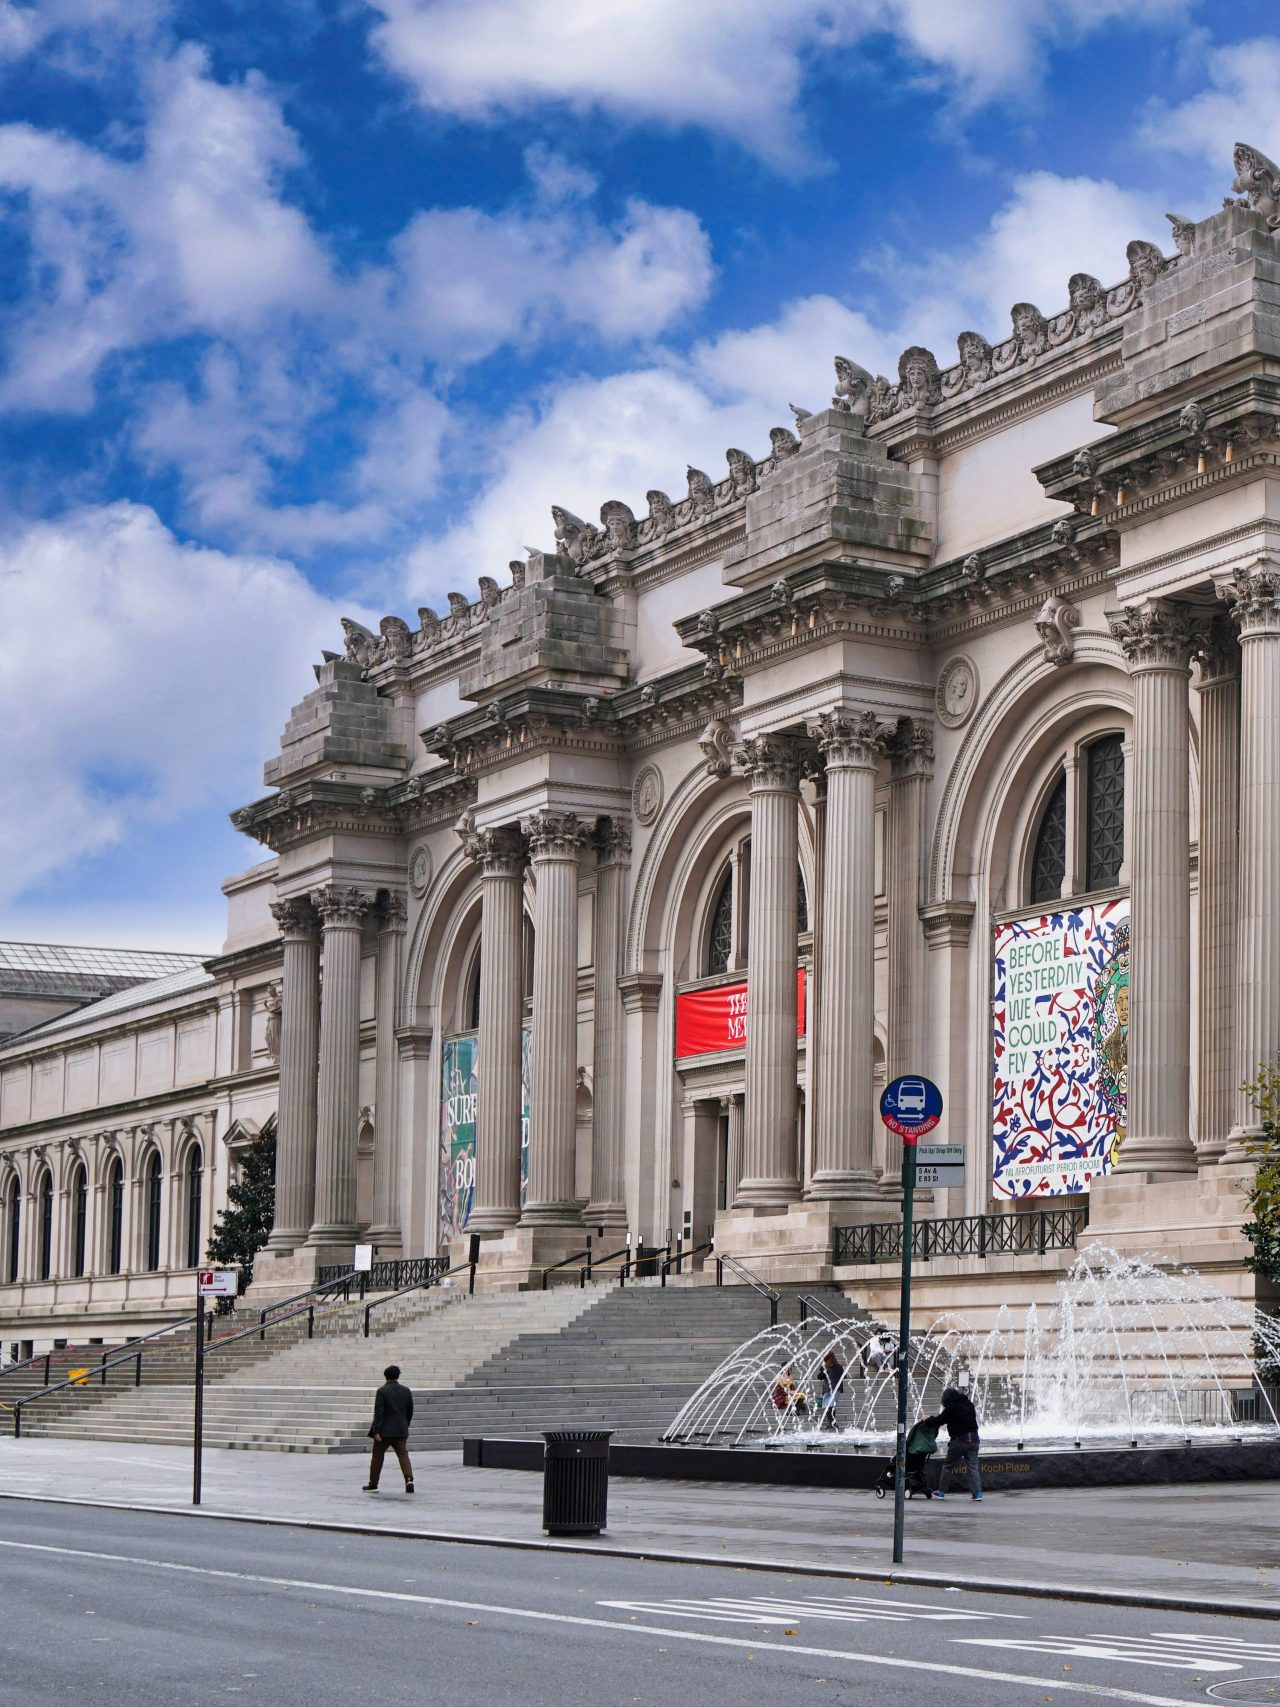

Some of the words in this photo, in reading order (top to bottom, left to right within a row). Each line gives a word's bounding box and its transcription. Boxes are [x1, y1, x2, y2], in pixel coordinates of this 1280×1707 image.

[1009, 938, 1061, 969] BEFORE
[1009, 961, 1083, 995] YESTERDAY
[1009, 998, 1031, 1021] WE
[1008, 1020, 1057, 1048] COULD
[1008, 1051, 1027, 1075] FLY
[886, 1118, 898, 1129] NO
[899, 1119, 935, 1134] STANDING
[936, 1147, 945, 1156] Drop
[1014, 1163, 1055, 1177] AFROFUTURIST
[1056, 1161, 1078, 1173] PERIOD
[1079, 1159, 1100, 1170] ROOM
[951, 1465, 967, 1474] vid
[981, 1463, 1004, 1473] Koch
[1006, 1462, 1030, 1472] Plaza
